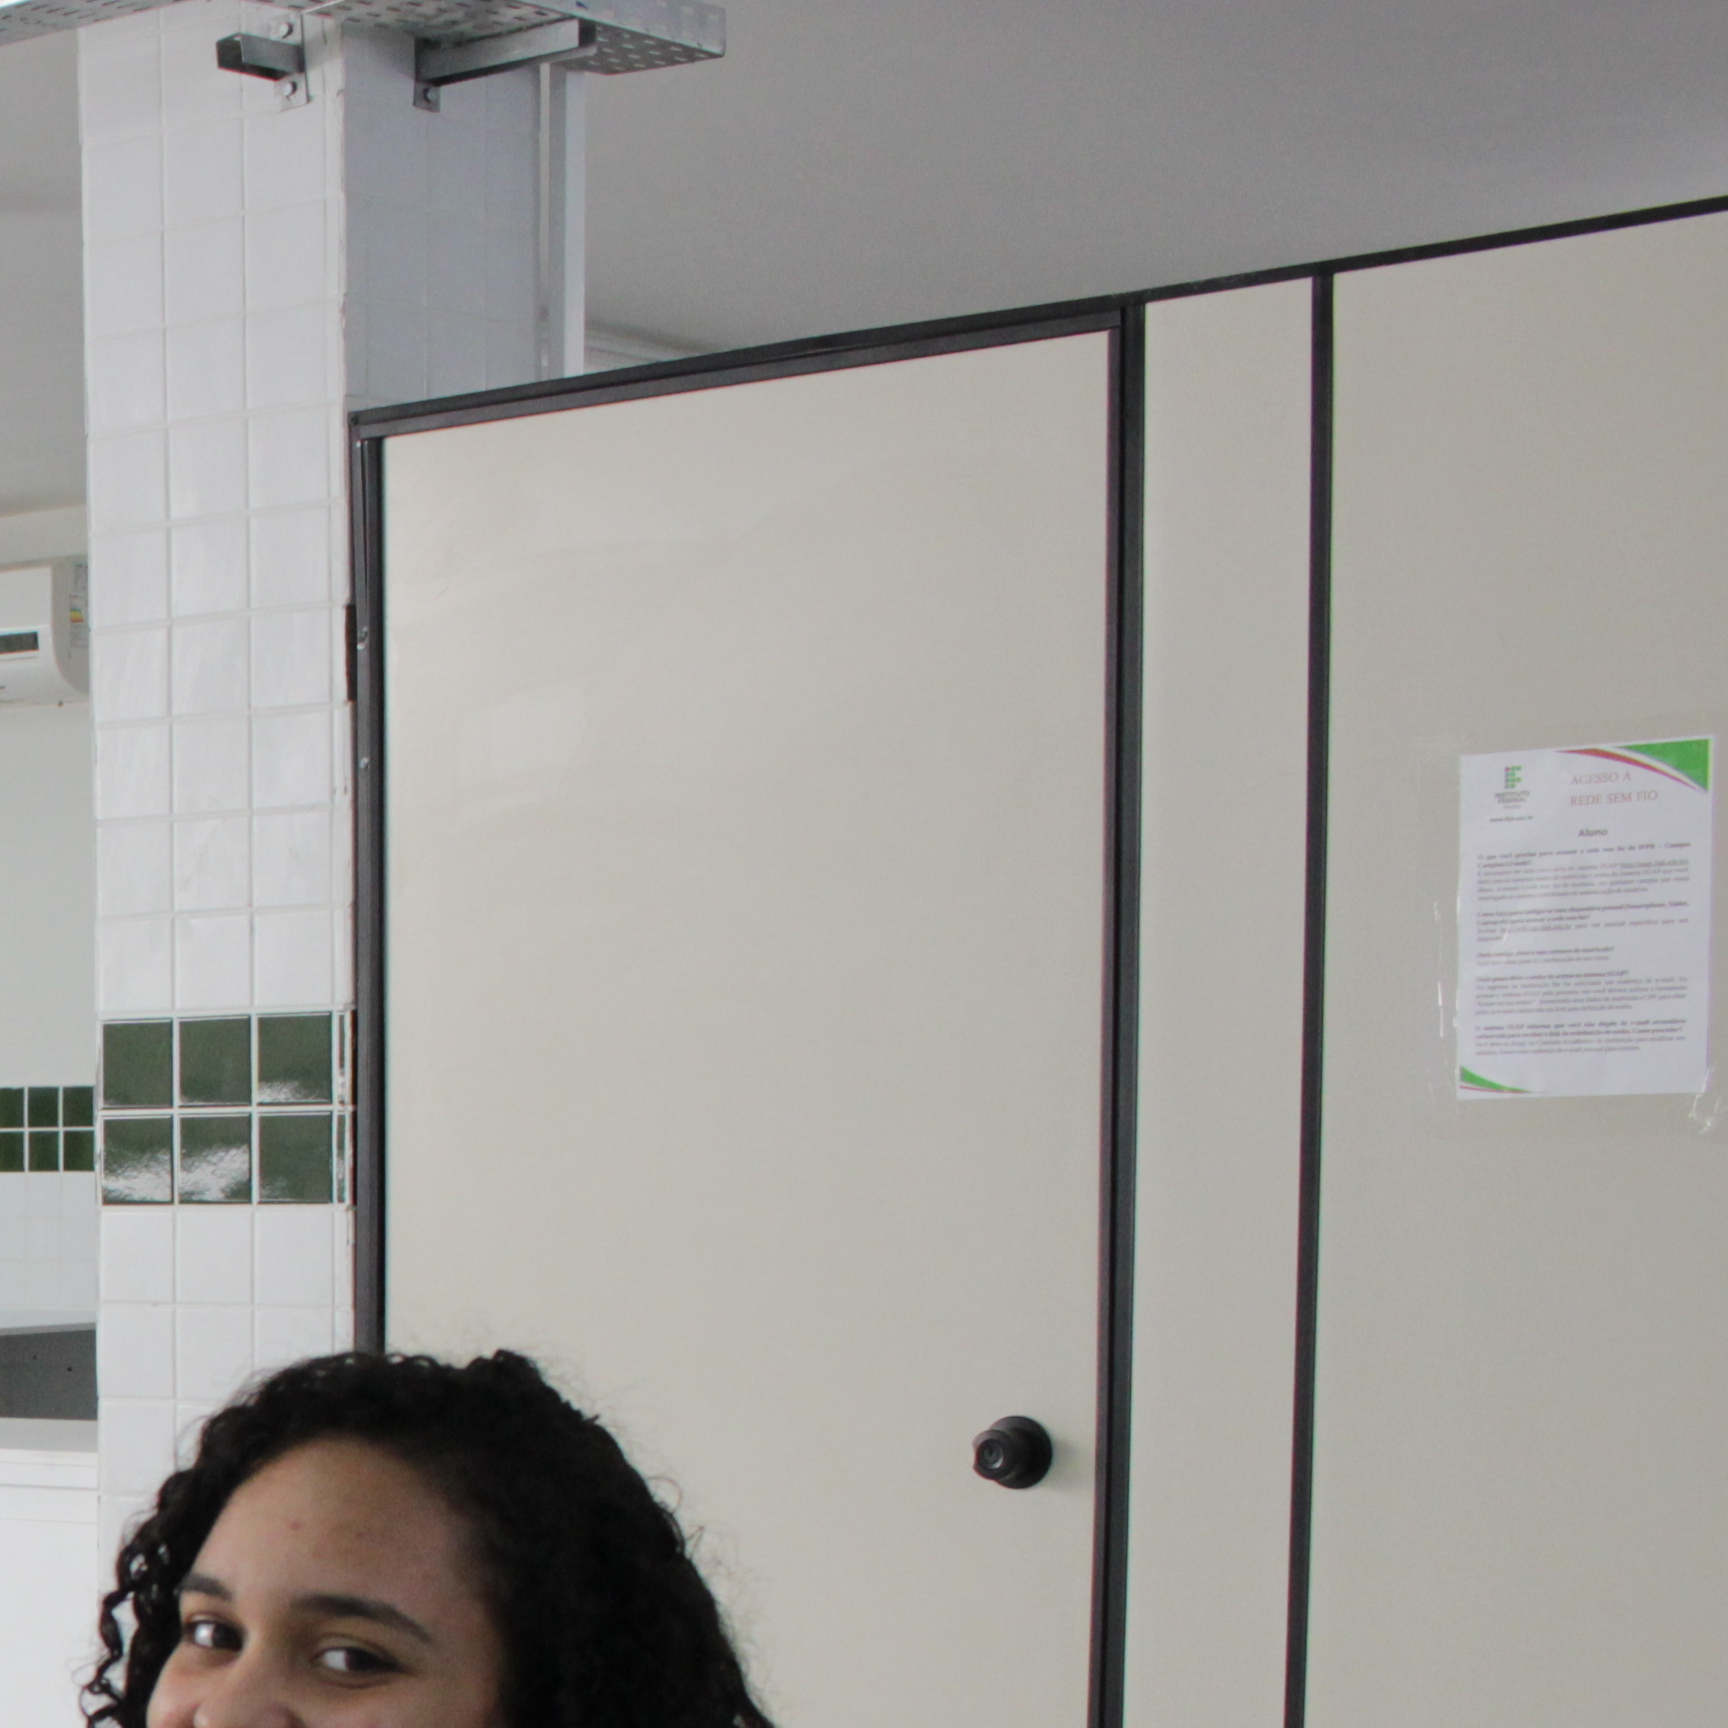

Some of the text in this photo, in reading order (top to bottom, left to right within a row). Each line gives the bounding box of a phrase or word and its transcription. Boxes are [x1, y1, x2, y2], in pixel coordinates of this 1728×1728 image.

[1570, 771, 1632, 785] ACESSO A
[1570, 790, 1658, 807] REDE SEM FIO
[1578, 828, 1608, 838] Aluno
